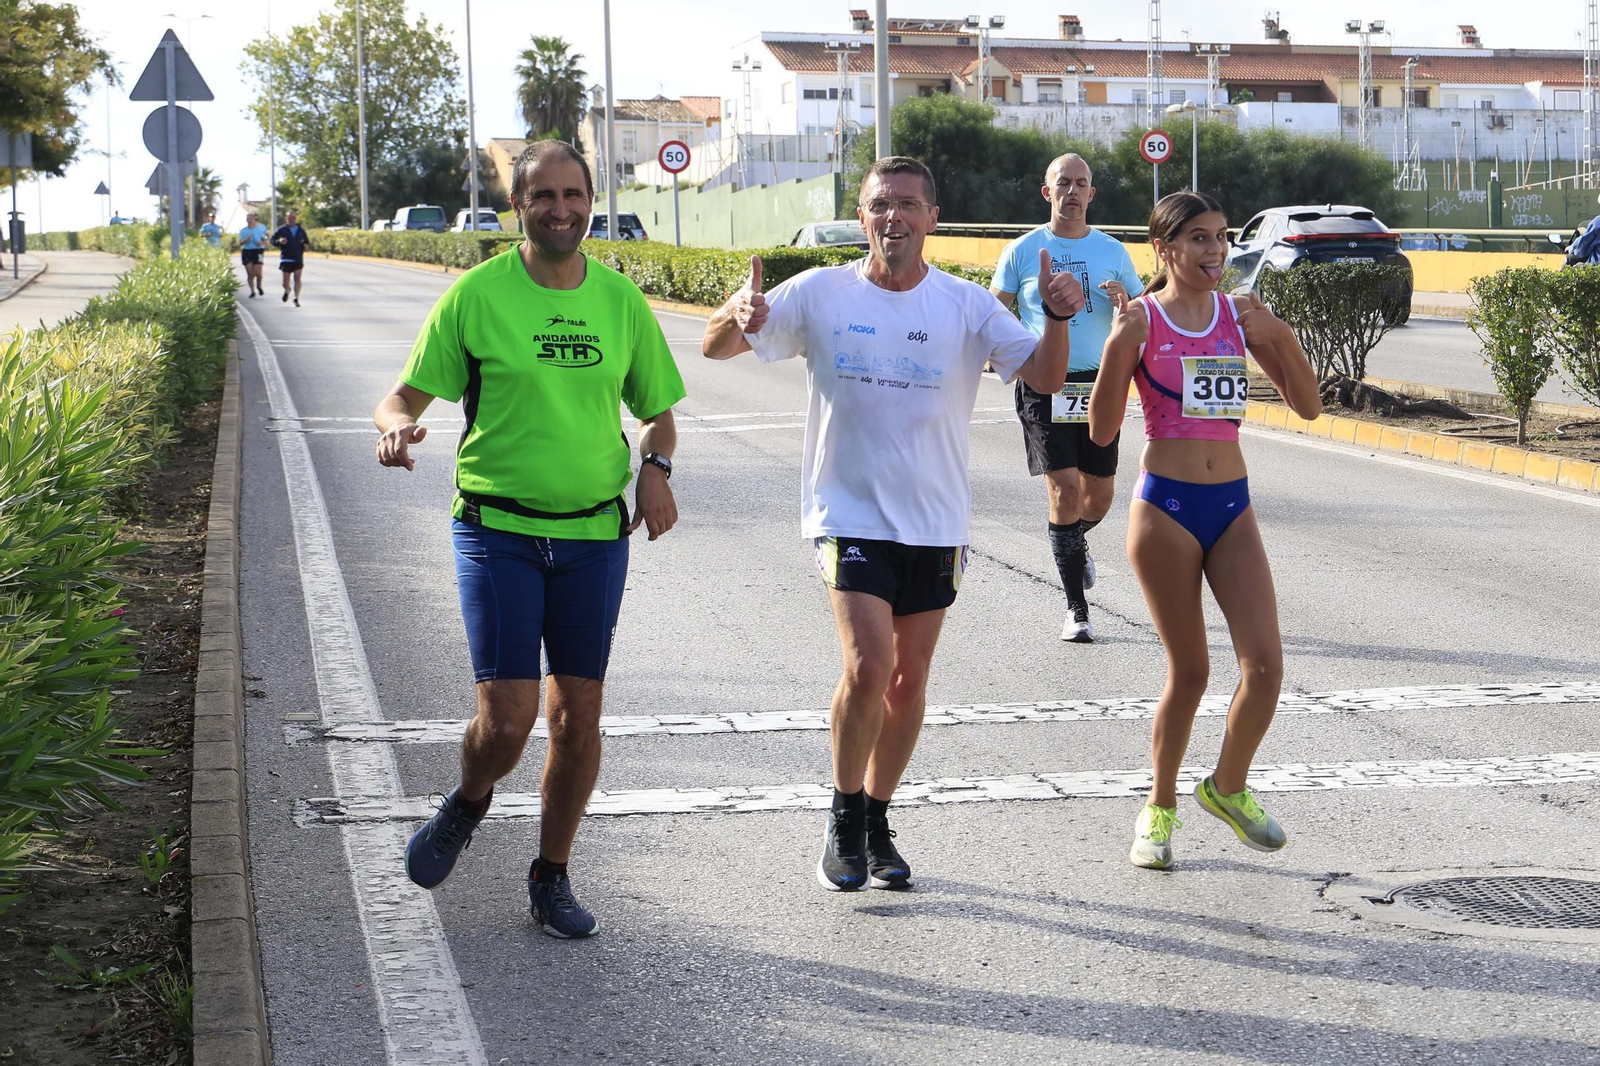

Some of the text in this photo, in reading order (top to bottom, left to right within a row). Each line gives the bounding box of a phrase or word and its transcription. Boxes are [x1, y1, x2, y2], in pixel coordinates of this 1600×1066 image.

[1148, 141, 1166, 152] 50
[666, 151, 684, 162] 50
[848, 324, 876, 335] HOKA
[533, 334, 600, 343] ANDAMIOS
[907, 330, 928, 344] edp
[1193, 376, 1248, 401] 303
